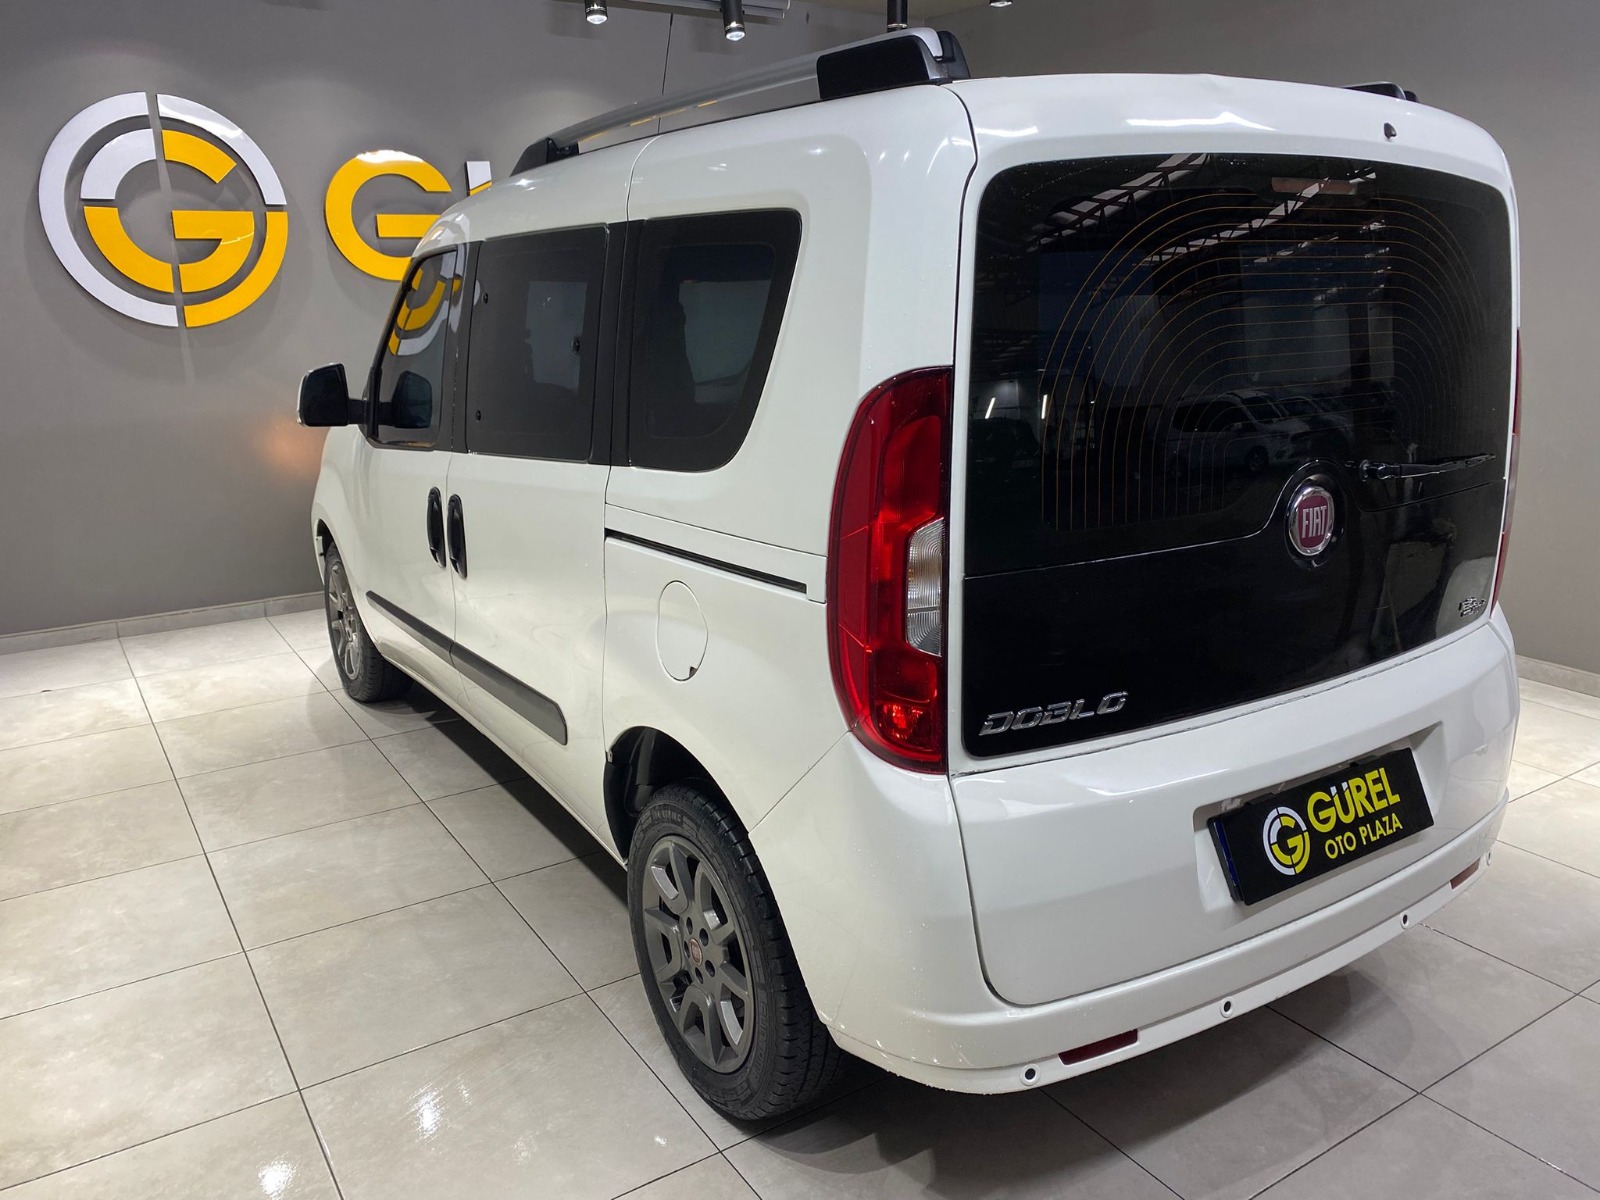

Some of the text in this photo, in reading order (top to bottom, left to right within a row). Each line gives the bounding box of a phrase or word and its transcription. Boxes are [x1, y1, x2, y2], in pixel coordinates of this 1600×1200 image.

[1301, 505, 1328, 539] FIAT
[979, 691, 1128, 736] DOBLO
[1306, 767, 1401, 833] GÜREL
[1324, 812, 1403, 860] OTO PLAZA
